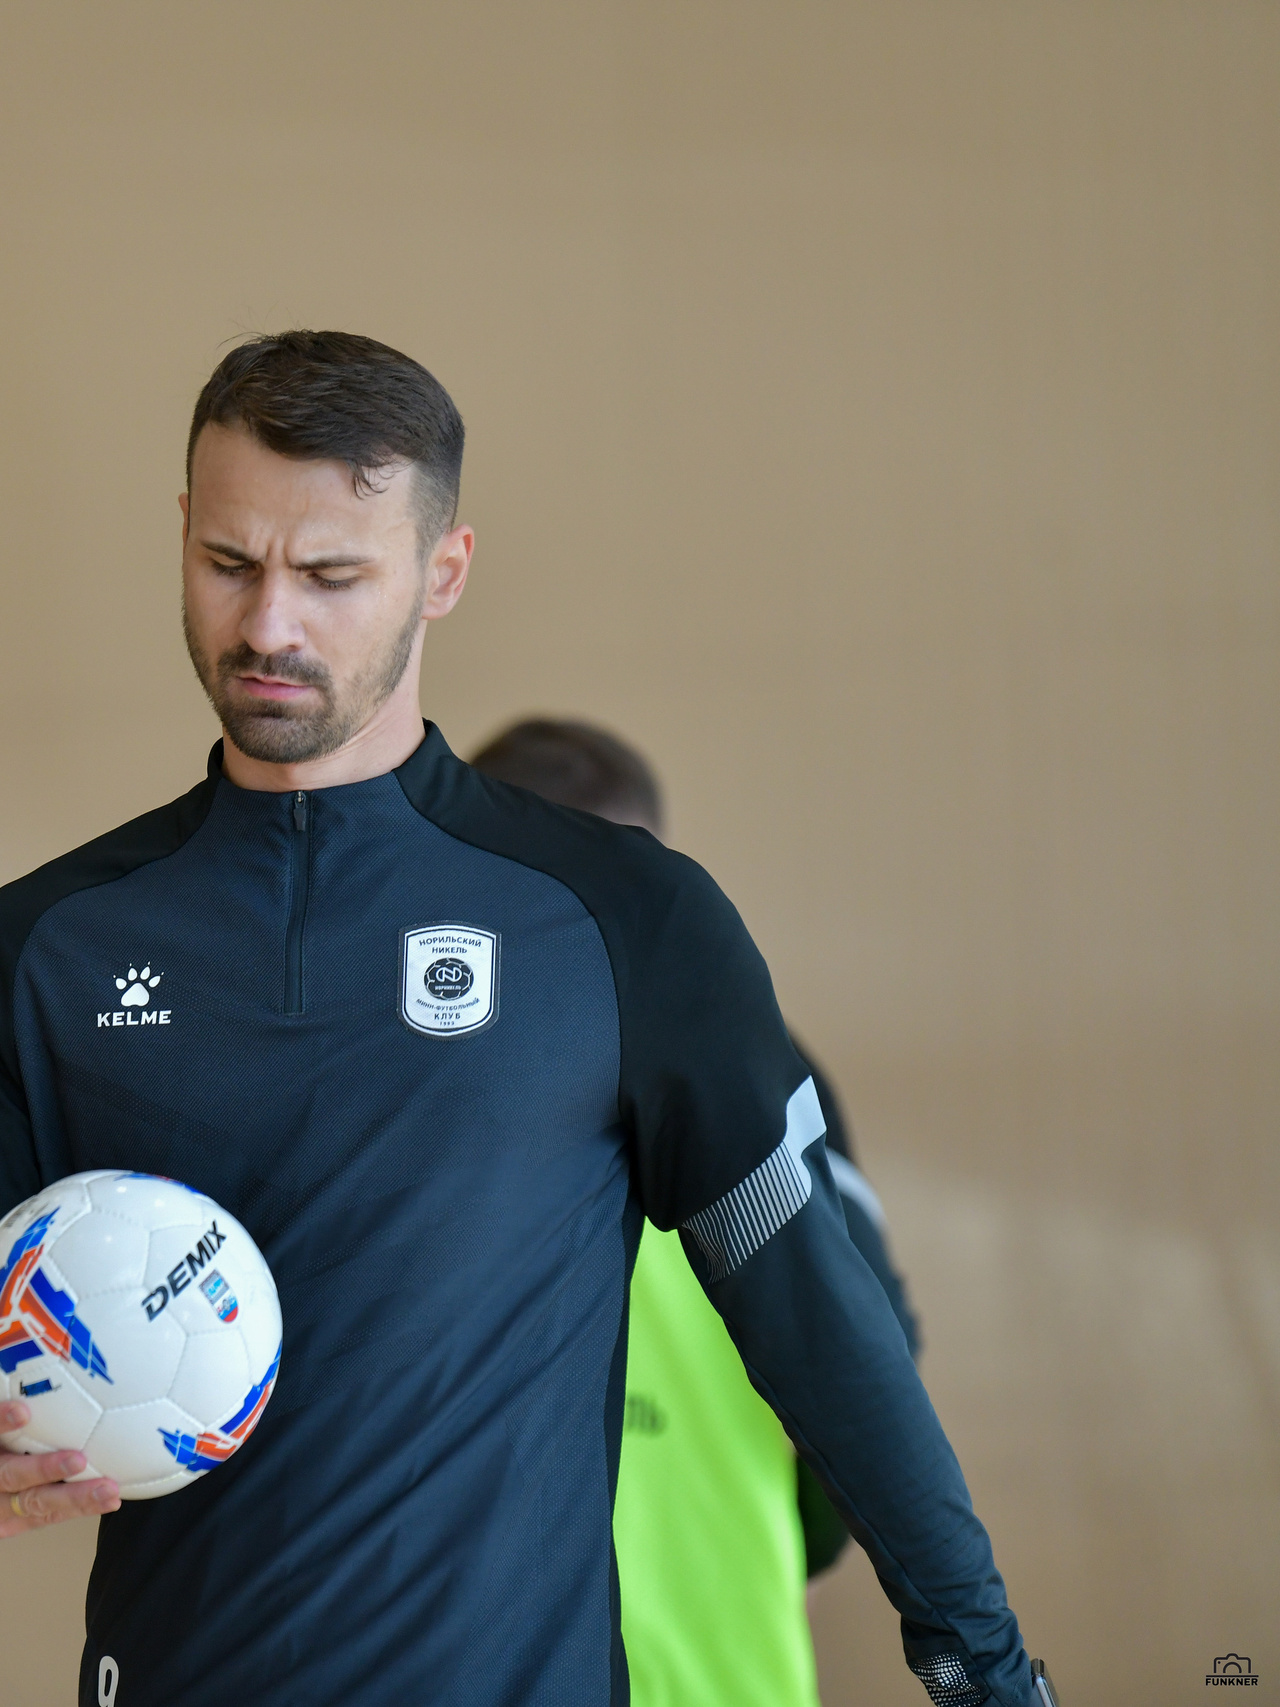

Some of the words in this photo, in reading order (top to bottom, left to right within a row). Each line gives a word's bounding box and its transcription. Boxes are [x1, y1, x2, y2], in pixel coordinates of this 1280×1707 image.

[419, 936, 482, 948] НОРИЛЬСКИЙ
[97, 1010, 172, 1028] KELME
[141, 1219, 227, 1322] DEMIX
